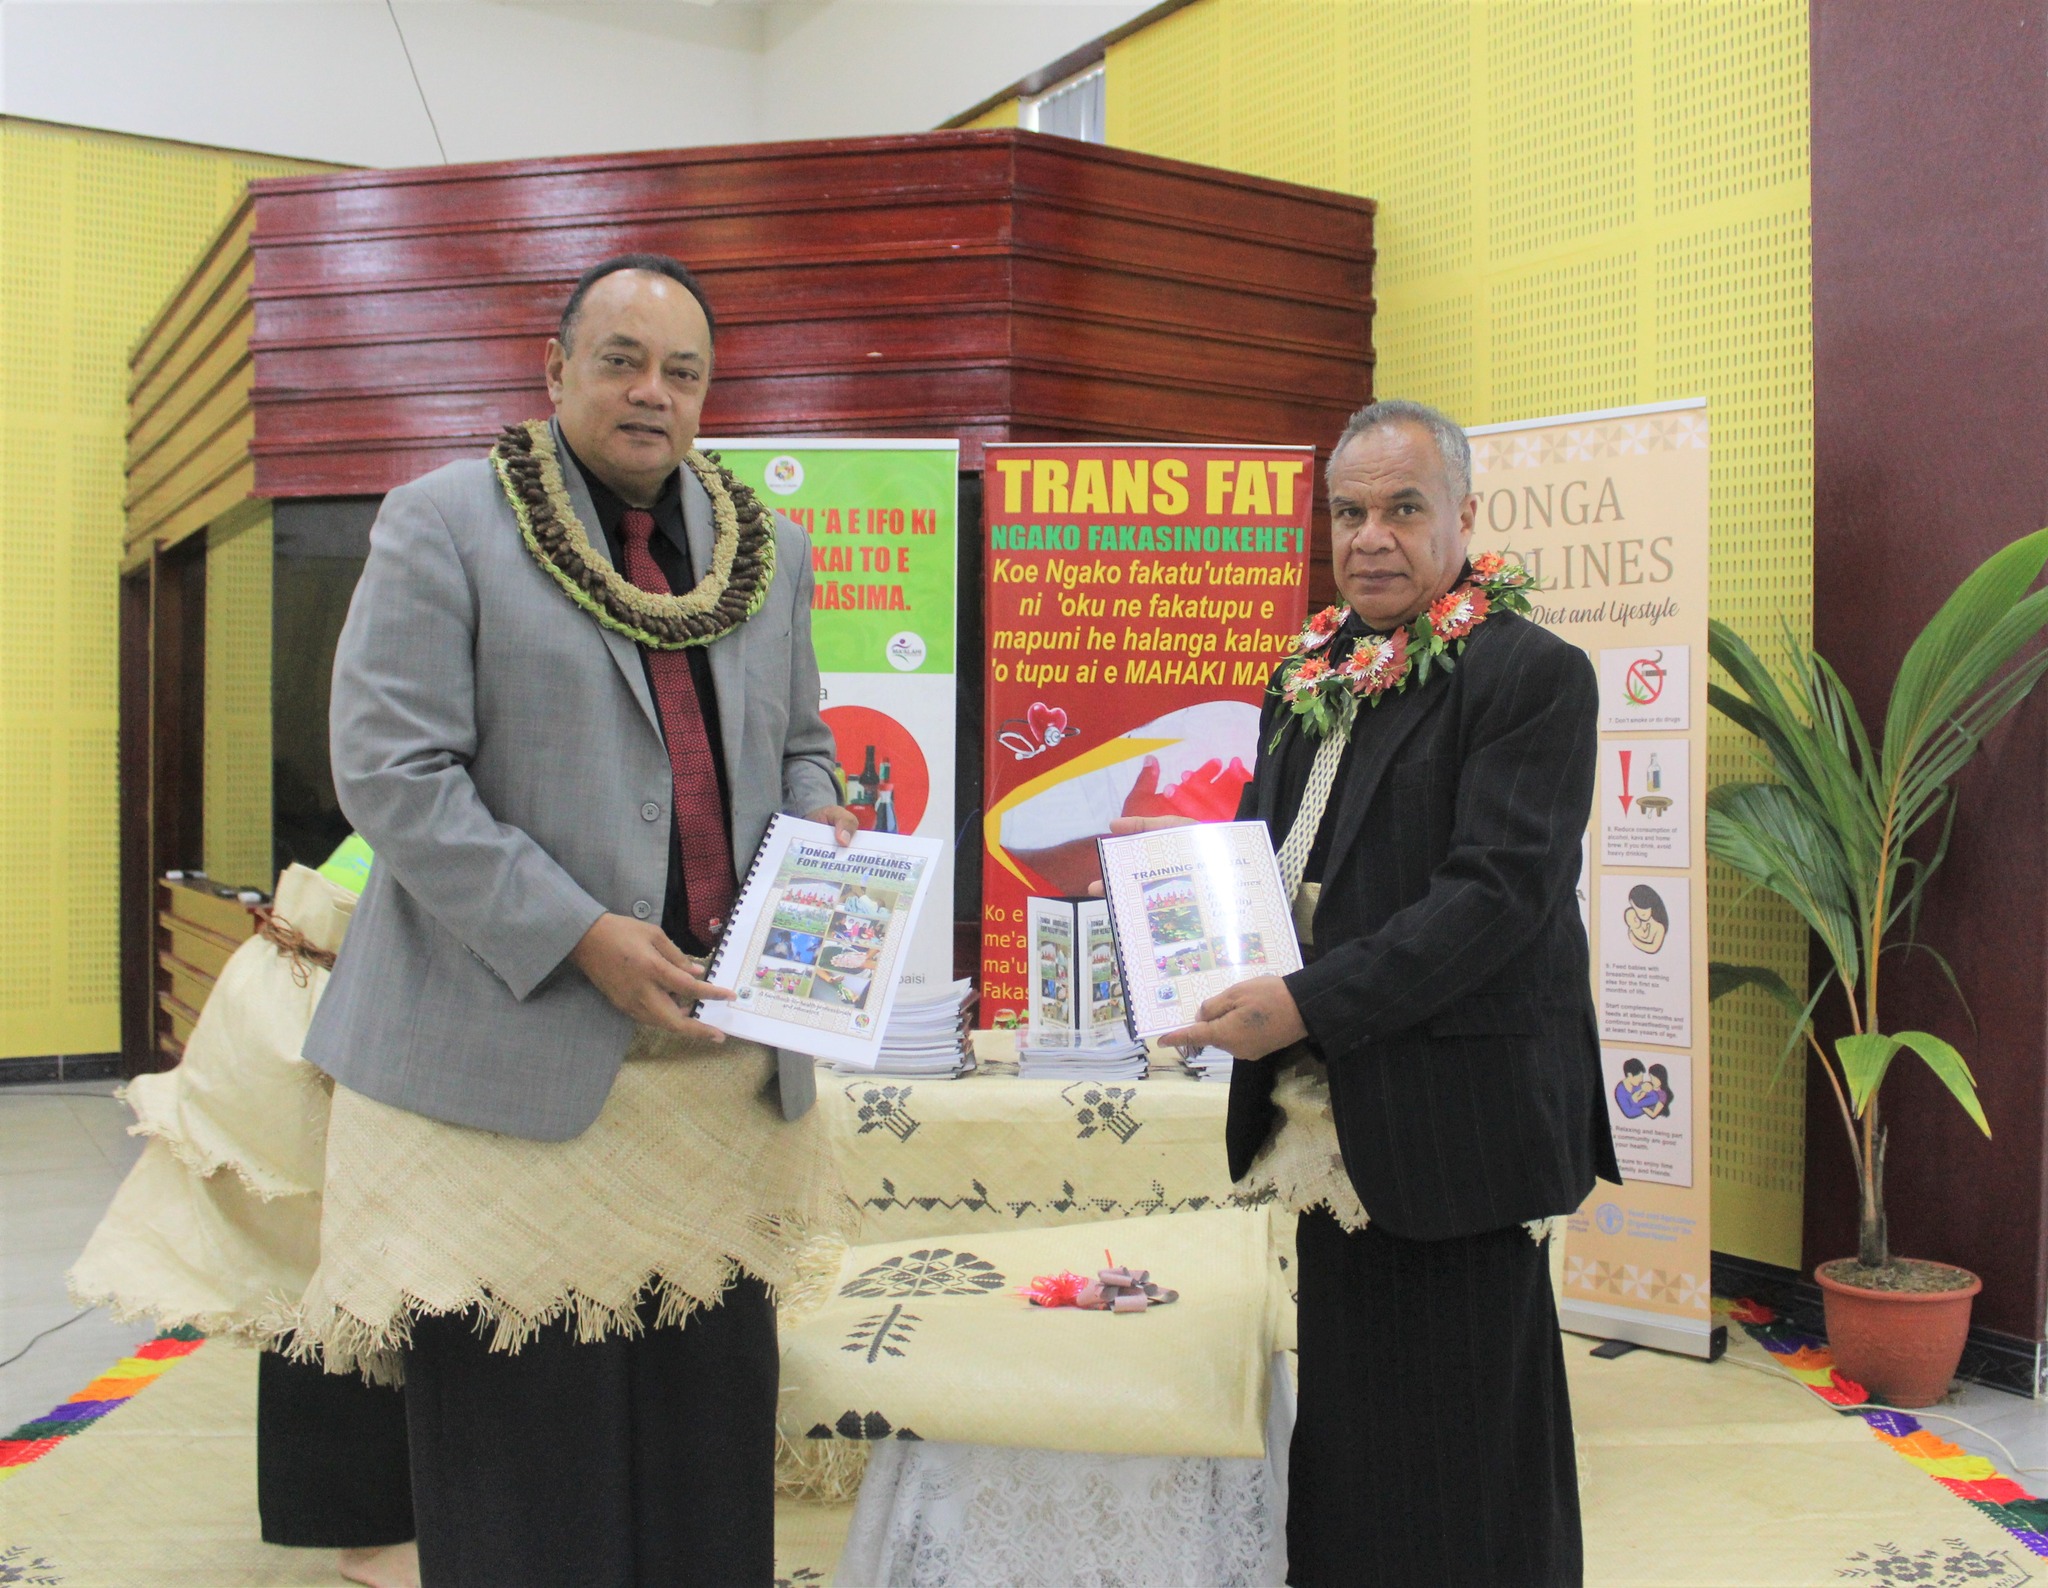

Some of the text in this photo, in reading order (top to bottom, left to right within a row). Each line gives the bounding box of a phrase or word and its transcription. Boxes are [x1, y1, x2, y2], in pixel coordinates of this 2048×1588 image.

[996, 458, 1303, 515] TRANS FAT
[775, 508, 814, 534] KI
[848, 508, 860, 534] E
[867, 508, 904, 534] IFO
[911, 508, 936, 534] KI
[991, 524, 1304, 553] NGAKO FAKASINOKEHE'I
[812, 546, 909, 573] KAI TO E
[993, 559, 1303, 590] Koe Ngako fakatu'utamaki
[1019, 592, 1275, 625] ni 'oku ne fakatupu e
[1531, 597, 1680, 628] Diet and Lifestyle
[993, 626, 1081, 655] mapuni
[1087, 626, 1116, 650] he
[1123, 626, 1217, 658] halanga
[992, 658, 1008, 682] 'o
[1016, 659, 1069, 689] tupu
[1076, 659, 1098, 683] ai
[1104, 664, 1118, 684] e
[1124, 660, 1226, 685] MAHAKI
[796, 857, 907, 882] FOR HEALTHY LIVING
[800, 846, 913, 871] TONGA GUIDELINES
[1131, 863, 1194, 881] TRAINING
[985, 904, 1024, 922] Ko e
[984, 931, 1027, 948] me'a
[984, 957, 1028, 974] ma'u
[1652, 1014, 1673, 1022] months
[1615, 1126, 1641, 1135] Relaxing
[1618, 1135, 1650, 1143] community
